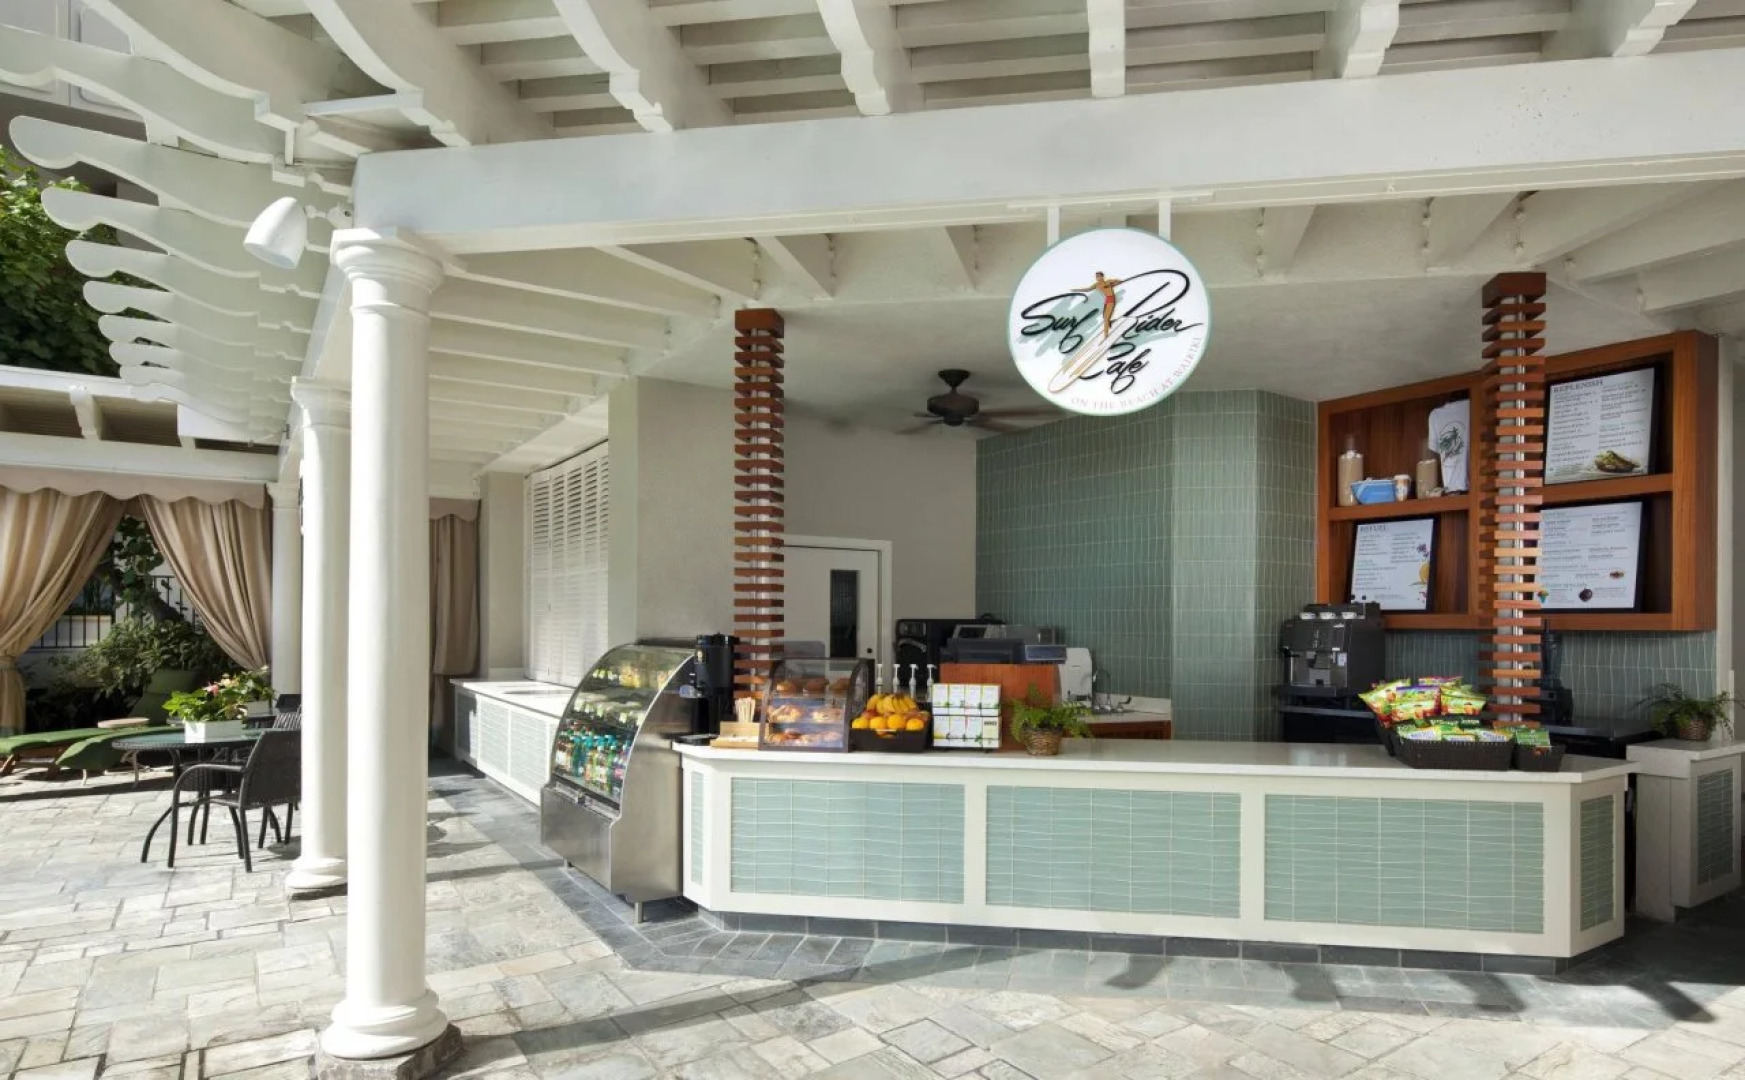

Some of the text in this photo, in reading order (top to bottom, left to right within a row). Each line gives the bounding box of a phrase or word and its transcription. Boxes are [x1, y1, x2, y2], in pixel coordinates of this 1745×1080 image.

[1021, 269, 1204, 353] Surf Rider
[1071, 397, 1089, 408] ON
[1093, 400, 1114, 409] THE
[1120, 388, 1158, 407] BEACH
[1161, 377, 1174, 390] AT
